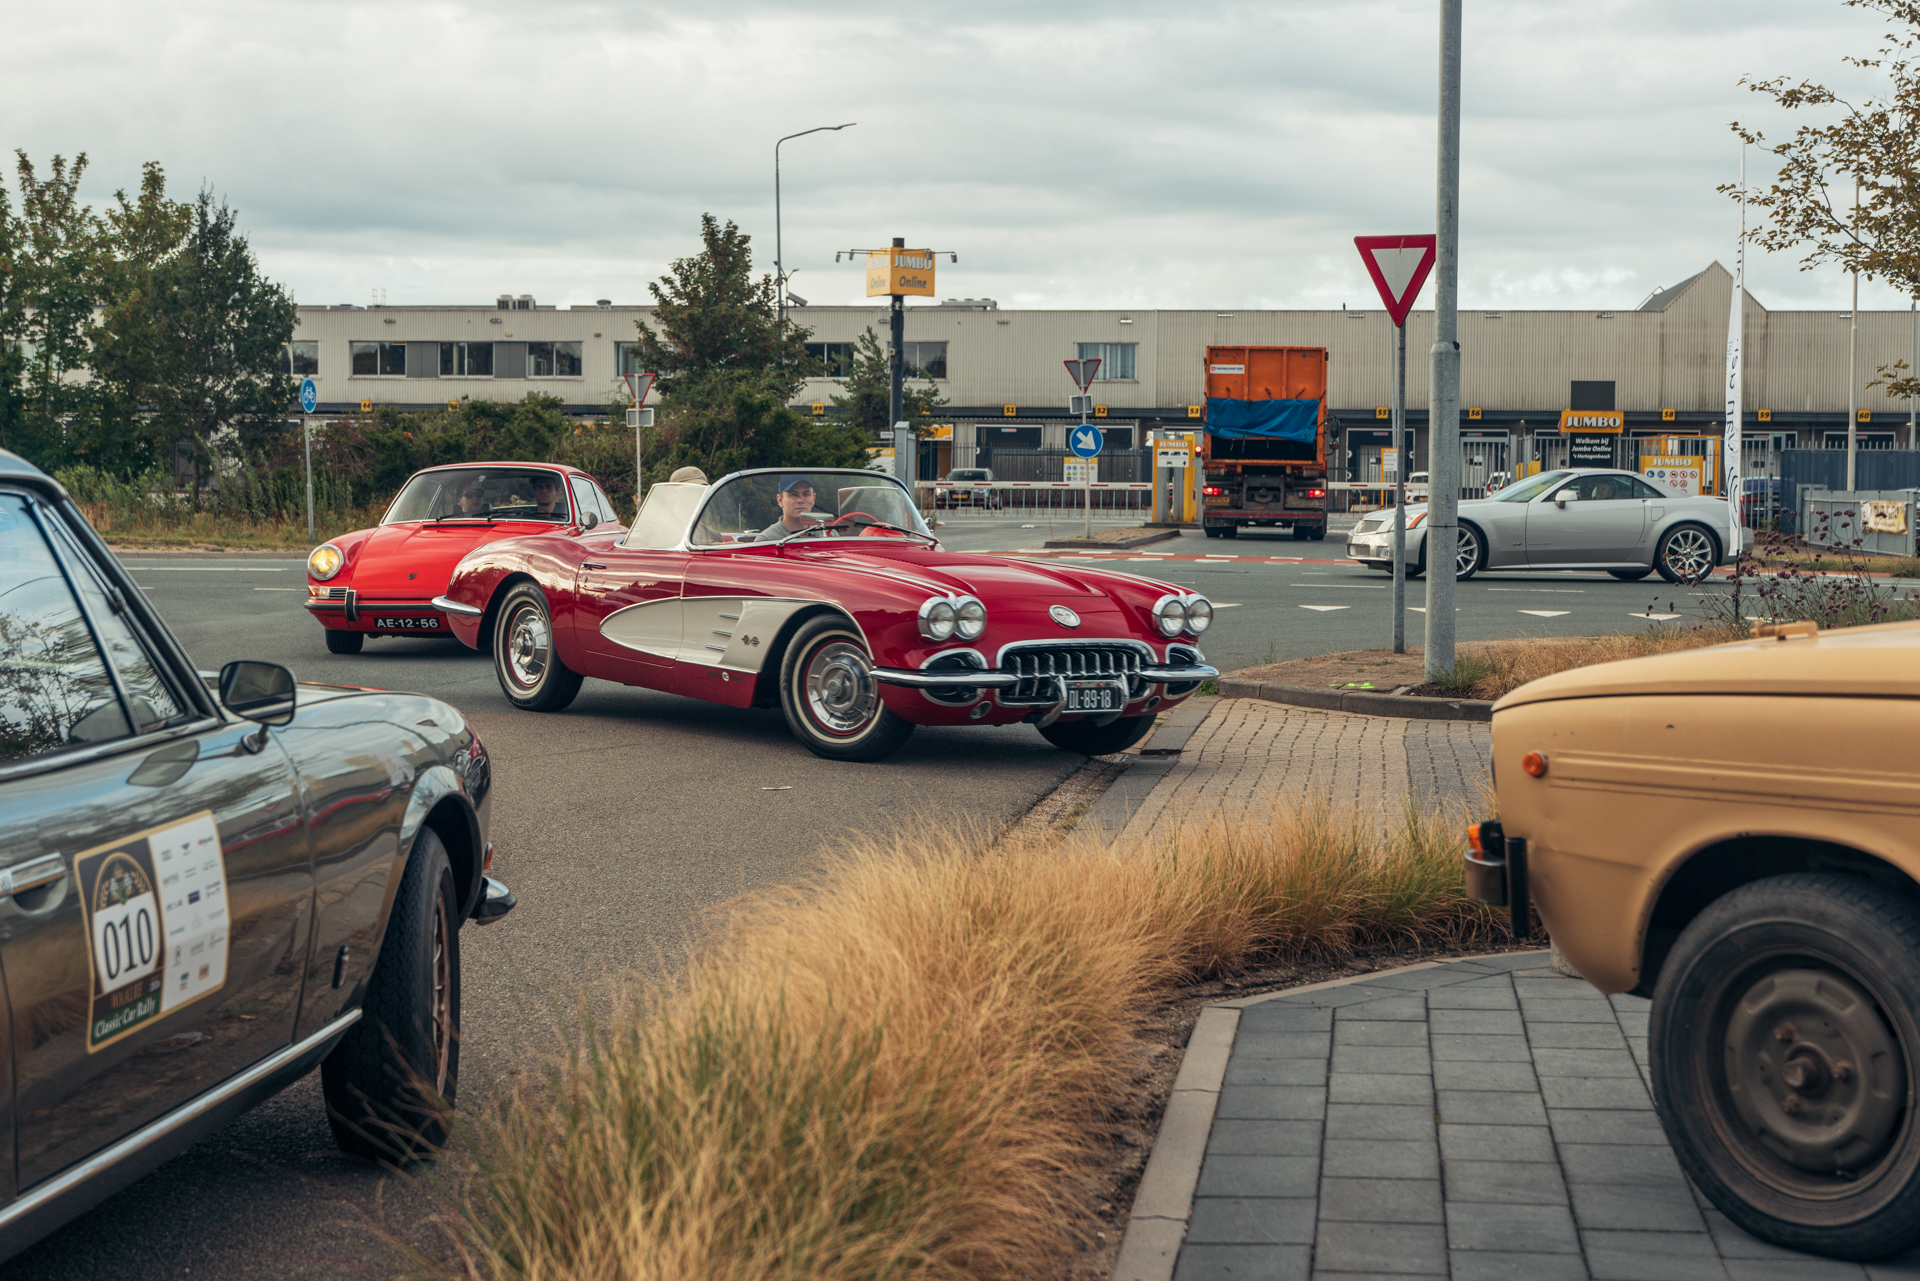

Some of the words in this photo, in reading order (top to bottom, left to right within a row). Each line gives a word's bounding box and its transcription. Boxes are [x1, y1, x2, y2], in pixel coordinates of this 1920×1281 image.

[868, 256, 888, 270] JUMBO
[894, 255, 932, 270] JUMBO
[899, 276, 927, 288] Online
[1565, 416, 1620, 428] JUMBO
[1600, 437, 1609, 445] bij
[1652, 458, 1692, 467] JUMBO
[377, 618, 439, 628] AE-12-56
[1069, 689, 1111, 709] DL-89-18
[103, 907, 154, 980] 010
[94, 1013, 122, 1038] Classic
[122, 1008, 136, 1025] Car
[136, 996, 156, 1018] Rally
